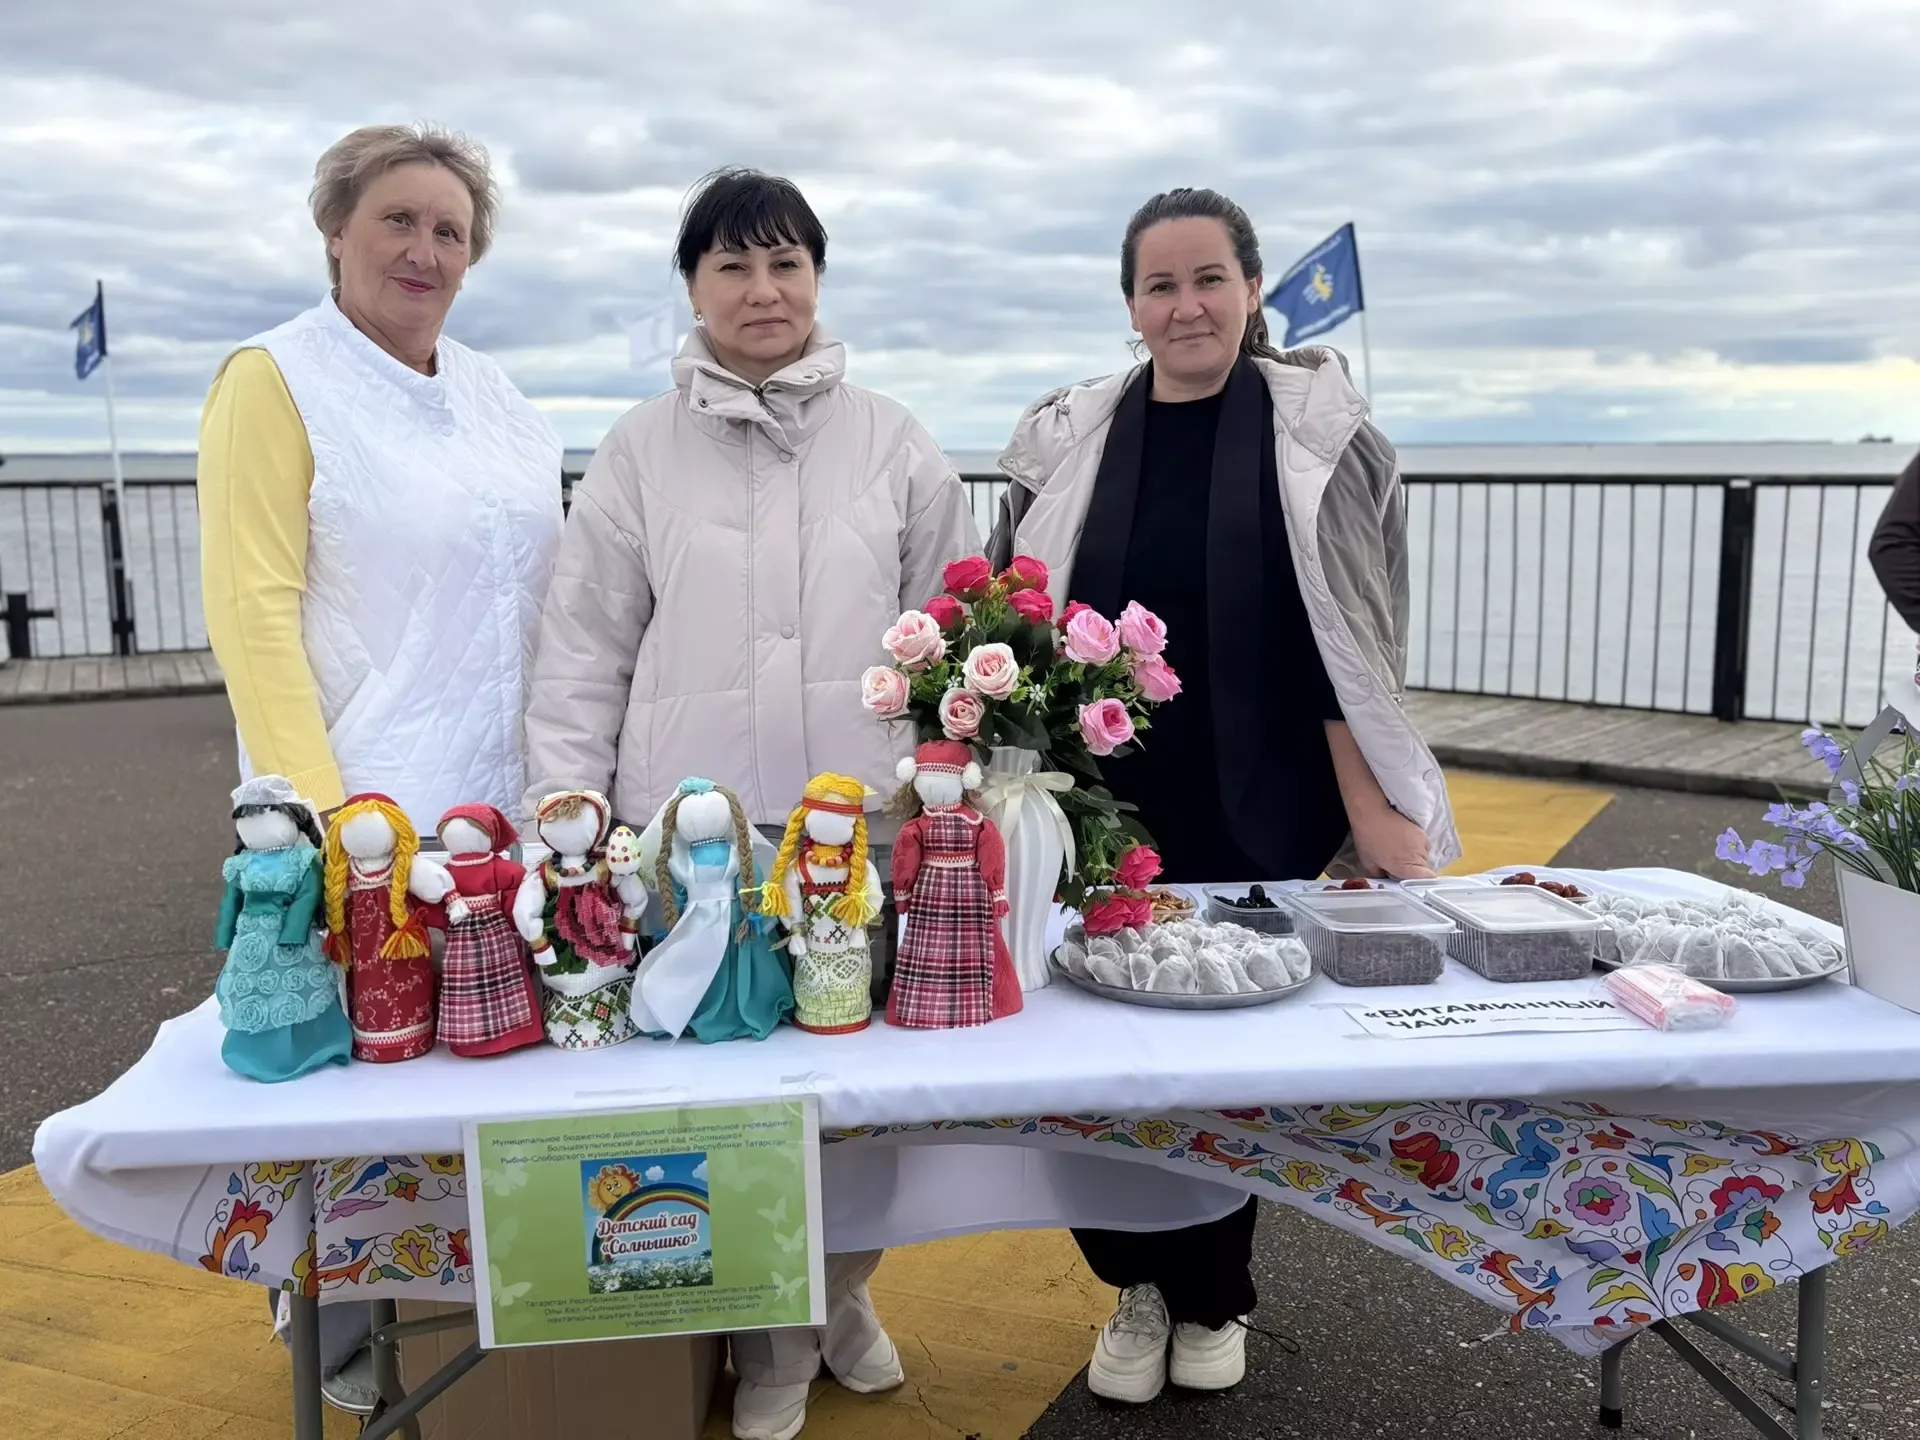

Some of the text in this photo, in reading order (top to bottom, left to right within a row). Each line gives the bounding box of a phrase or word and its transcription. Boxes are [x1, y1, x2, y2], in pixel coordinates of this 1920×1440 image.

[1364, 999, 1615, 1020] «ВИТАМИННЫЙ
[1385, 1014, 1478, 1030] ЧАЙ»
[492, 1136, 560, 1147] Муниципальное
[563, 1132, 610, 1142] бюджетное
[613, 1129, 665, 1140] дошкольное
[667, 1124, 739, 1135] образовательное
[635, 1136, 668, 1147] детский
[671, 1135, 686, 1144] сад
[689, 1132, 742, 1142] «Солнышко»
[501, 1152, 585, 1164] Рыбно-Слободского
[588, 1147, 658, 1159] муниципального
[660, 1145, 690, 1155] района
[693, 1141, 741, 1152] Республики
[598, 1212, 697, 1236] Детский сад
[602, 1232, 698, 1255] «Солнышко»
[749, 1284, 780, 1294] районы
